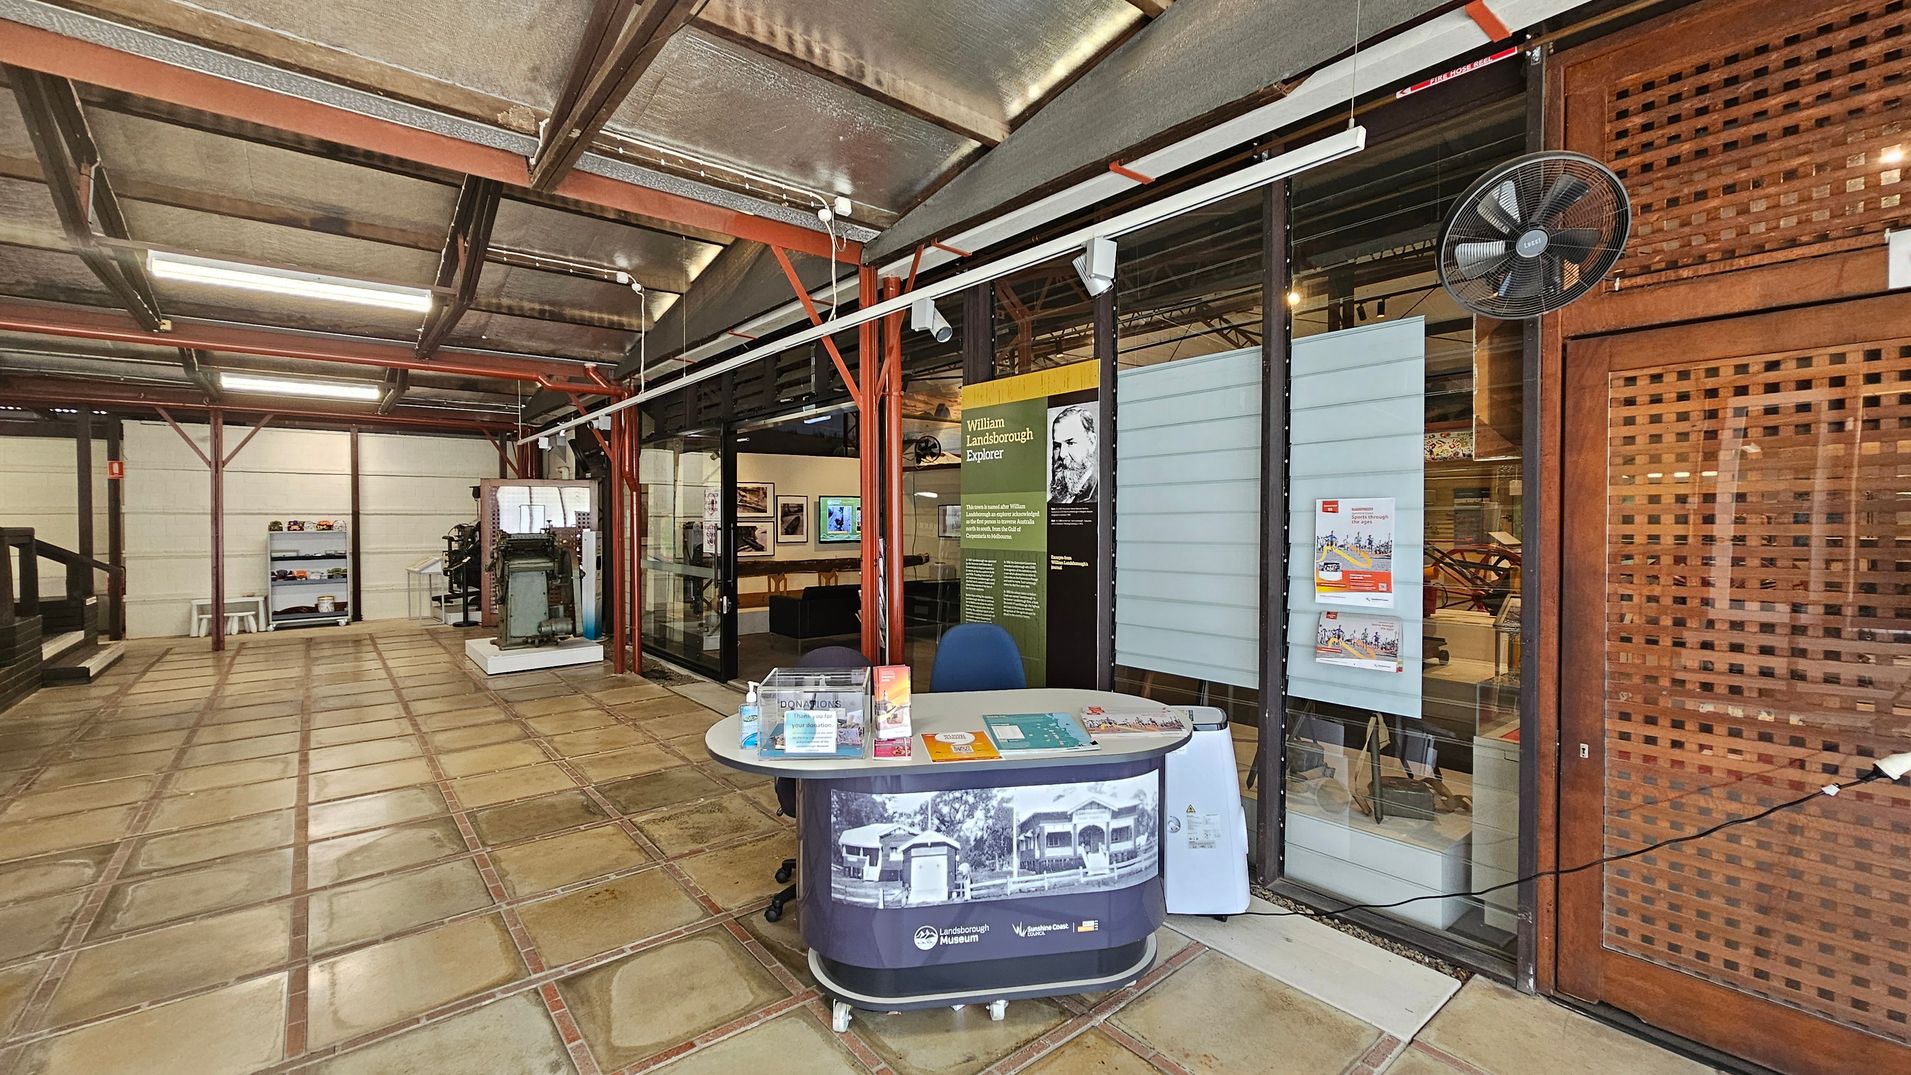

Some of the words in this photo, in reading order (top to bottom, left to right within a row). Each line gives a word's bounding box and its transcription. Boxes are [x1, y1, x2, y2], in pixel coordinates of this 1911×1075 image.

[1430, 73, 1448, 85] FIRE
[1450, 65, 1472, 77] HOSE
[1473, 56, 1493, 68] REEL
[966, 417, 1005, 432] William
[966, 428, 1034, 447] Landsborough
[966, 448, 1004, 463] Explorer
[780, 699, 842, 709] DONATIONS
[939, 923, 990, 936] Landsborough
[1027, 924, 1052, 932] Sunshine
[1052, 922, 1070, 931] Coast
[939, 933, 979, 945] Museum
